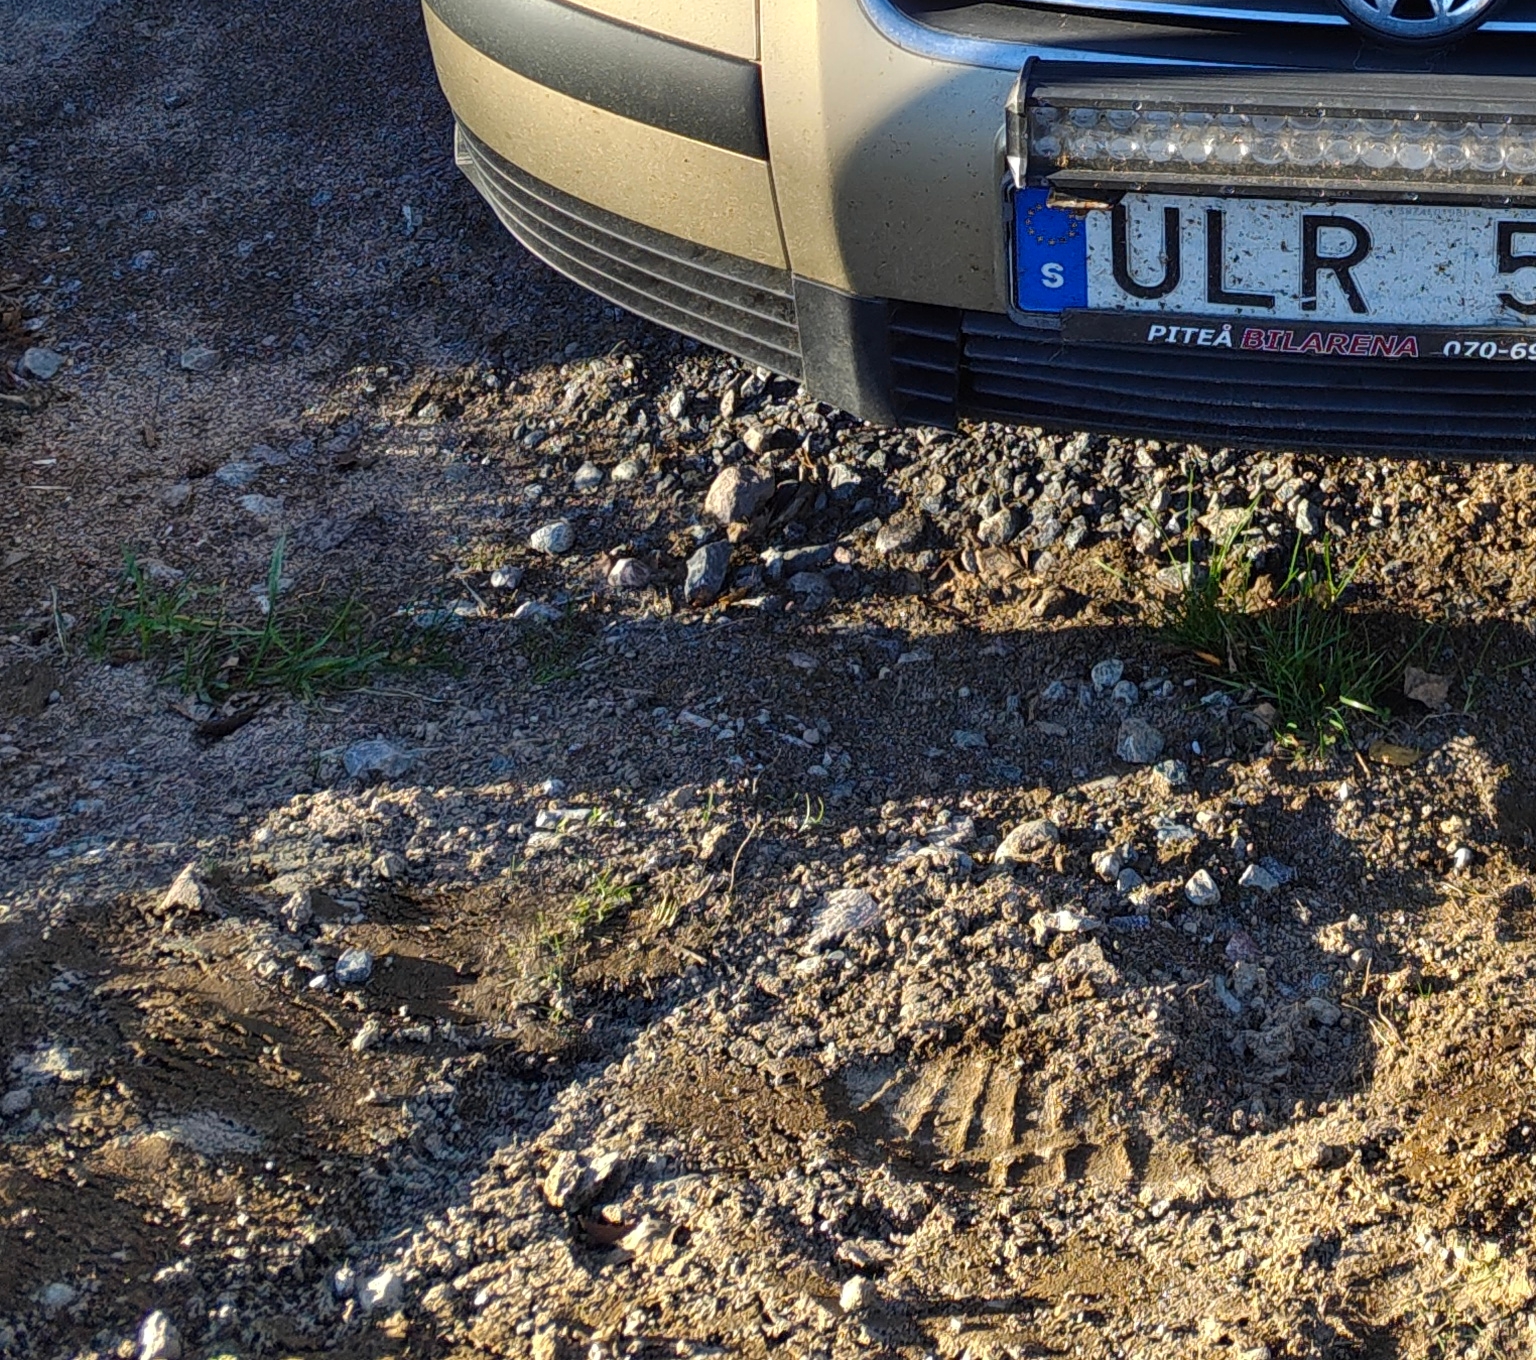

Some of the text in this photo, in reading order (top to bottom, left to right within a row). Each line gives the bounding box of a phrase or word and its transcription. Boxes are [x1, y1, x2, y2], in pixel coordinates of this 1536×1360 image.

[1040, 262, 1065, 289] S
[1111, 204, 1373, 315] ULR
[1148, 323, 1232, 348] PITEÅ
[1239, 328, 1419, 358] BILARENA
